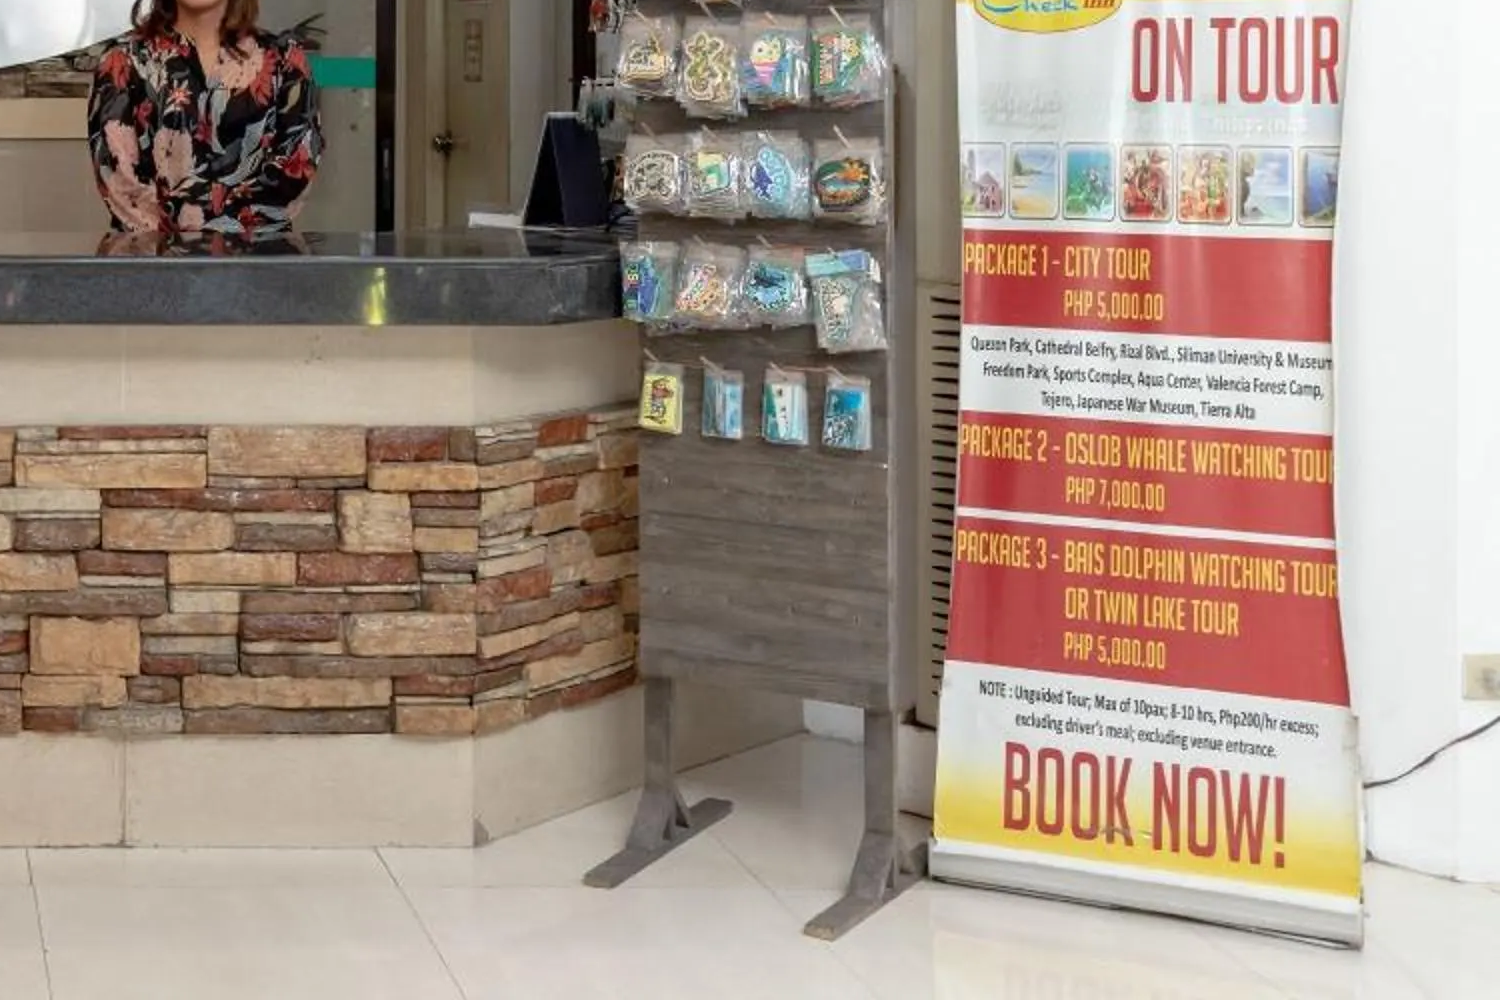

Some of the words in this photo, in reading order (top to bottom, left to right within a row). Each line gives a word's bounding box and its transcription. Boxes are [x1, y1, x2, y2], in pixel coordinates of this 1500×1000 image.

[1132, 17, 1193, 103] ON
[1210, 16, 1339, 104] TOUR
[964, 242, 1036, 276] PACKAGE
[1041, 245, 1049, 277] 1
[1064, 245, 1102, 278] CITY
[1106, 247, 1151, 281] TOUR
[1064, 288, 1093, 317] PHP
[1097, 290, 1163, 321] 5,000.00
[1009, 337, 1032, 356] Park,
[1035, 338, 1083, 355] Cathedral
[1085, 342, 1117, 361] Belfry,
[1119, 343, 1143, 360] Rizal
[1218, 349, 1273, 370] University
[1275, 351, 1284, 368] &
[983, 361, 1025, 379] Freedom
[1027, 363, 1049, 381] Park,
[1053, 365, 1086, 384] Sports
[1088, 368, 1135, 388] Complex,
[1138, 371, 1164, 389] Aqua
[1166, 373, 1202, 392] Center,
[1206, 376, 1250, 393] Valencia
[1253, 378, 1286, 395] Forest
[1290, 382, 1324, 400] Camp,
[1041, 390, 1074, 409] Tejero,
[1077, 393, 1124, 412] Japanese
[1126, 396, 1146, 413] War
[1150, 398, 1198, 418] Museum,
[1200, 401, 1231, 418] Tierra
[1234, 403, 1256, 419] Alta
[960, 424, 1032, 461] PACKAGE
[1037, 430, 1047, 462] 2
[1065, 432, 1121, 467] OSLOB
[1126, 436, 1186, 472] WHALE
[1191, 440, 1286, 481] WATCHING
[1066, 476, 1094, 505] PHP
[1099, 479, 1165, 512] 7,000.00
[957, 530, 1031, 568] PACKAGE
[1036, 537, 1047, 570] 3
[1064, 540, 1104, 575] BAIS
[1110, 545, 1184, 583] DOLPHIN
[1190, 552, 1286, 593] WATCHING
[1065, 588, 1088, 620] OR
[1094, 589, 1138, 625] TWIN
[1143, 594, 1186, 631] LAKE
[1192, 600, 1239, 637] TOUR
[1063, 632, 1093, 660] PHP
[1098, 635, 1166, 669] 5,000.00
[979, 680, 1006, 698] NOTE
[1015, 684, 1063, 704] Unguided
[1094, 695, 1117, 711] Max
[1120, 697, 1131, 713] of
[1197, 705, 1217, 725] hrs,
[1219, 709, 1278, 732] Php200/hr
[1137, 727, 1188, 750] excluding
[1190, 736, 1224, 751] venue
[1003, 741, 1134, 846] BOOK
[1152, 761, 1285, 868] NOW!
